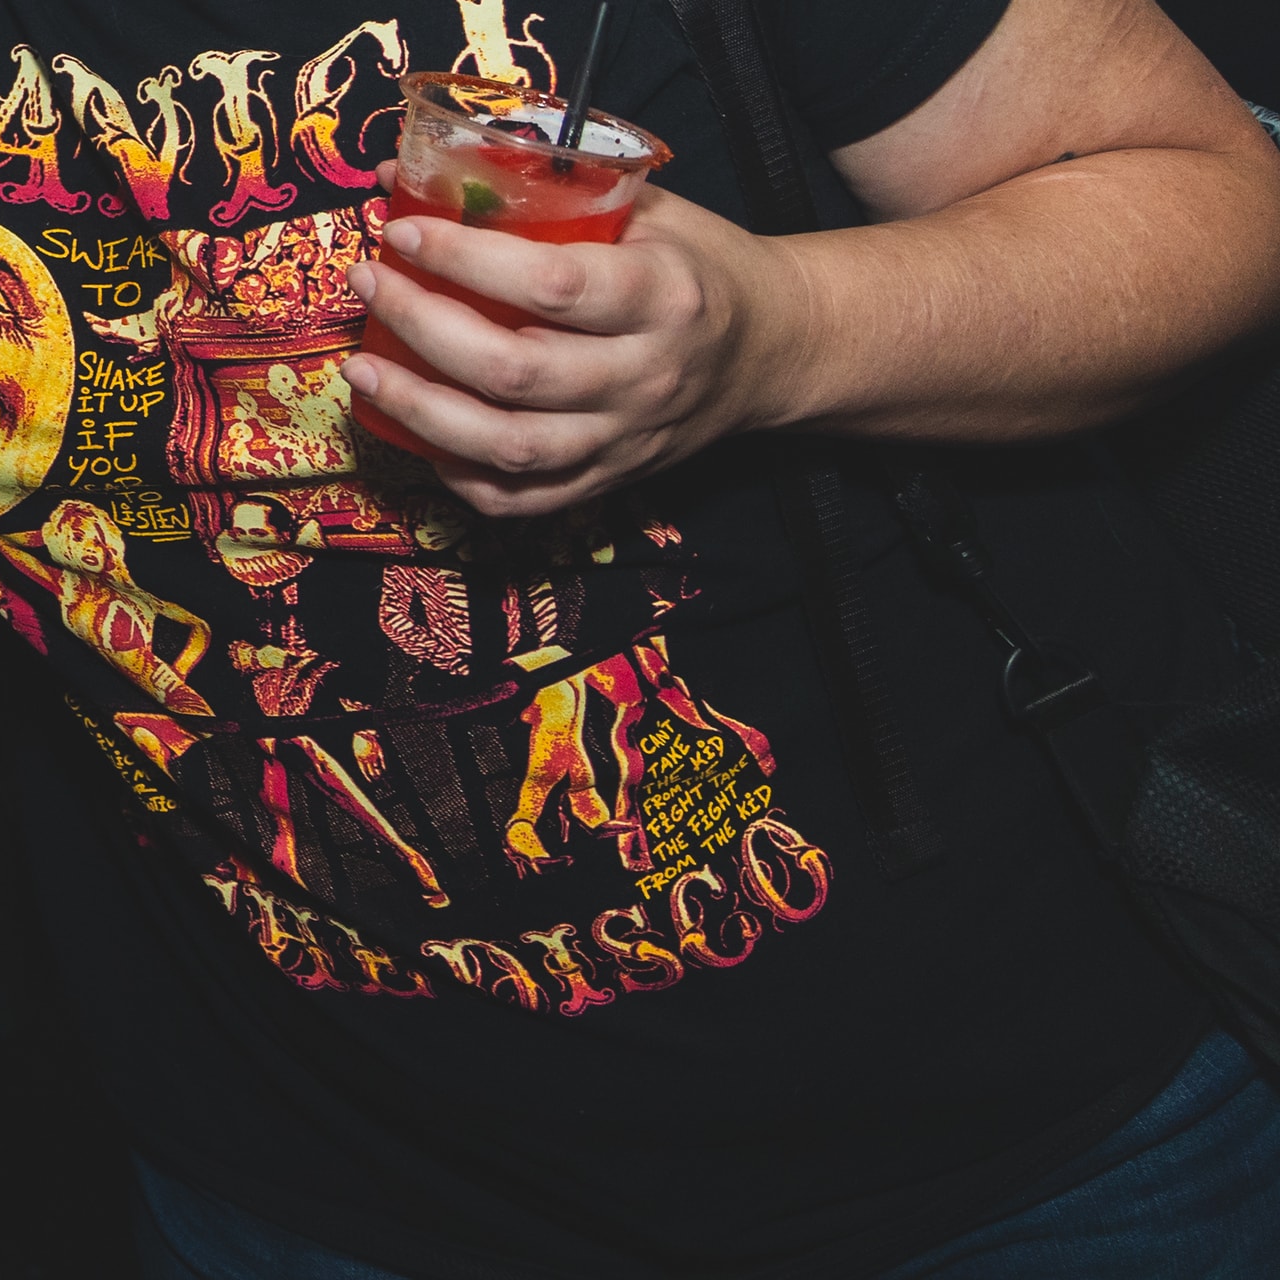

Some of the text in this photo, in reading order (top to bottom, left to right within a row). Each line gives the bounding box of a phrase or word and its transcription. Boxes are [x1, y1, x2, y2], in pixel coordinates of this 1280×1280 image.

[36, 227, 168, 273] SWEAR
[81, 282, 141, 308] TO
[78, 351, 166, 391] SHAKE
[119, 391, 166, 418] UP
[69, 454, 138, 487] YOU
[639, 718, 675, 755] CAN'T
[647, 733, 690, 779] TAKE
[643, 763, 685, 794] THE
[645, 753, 749, 839] FIGHT TAKE
[642, 784, 683, 817] FROM
[652, 780, 738, 862] THE FIGHT
[635, 853, 697, 901] FROM
[700, 817, 737, 855] THE
